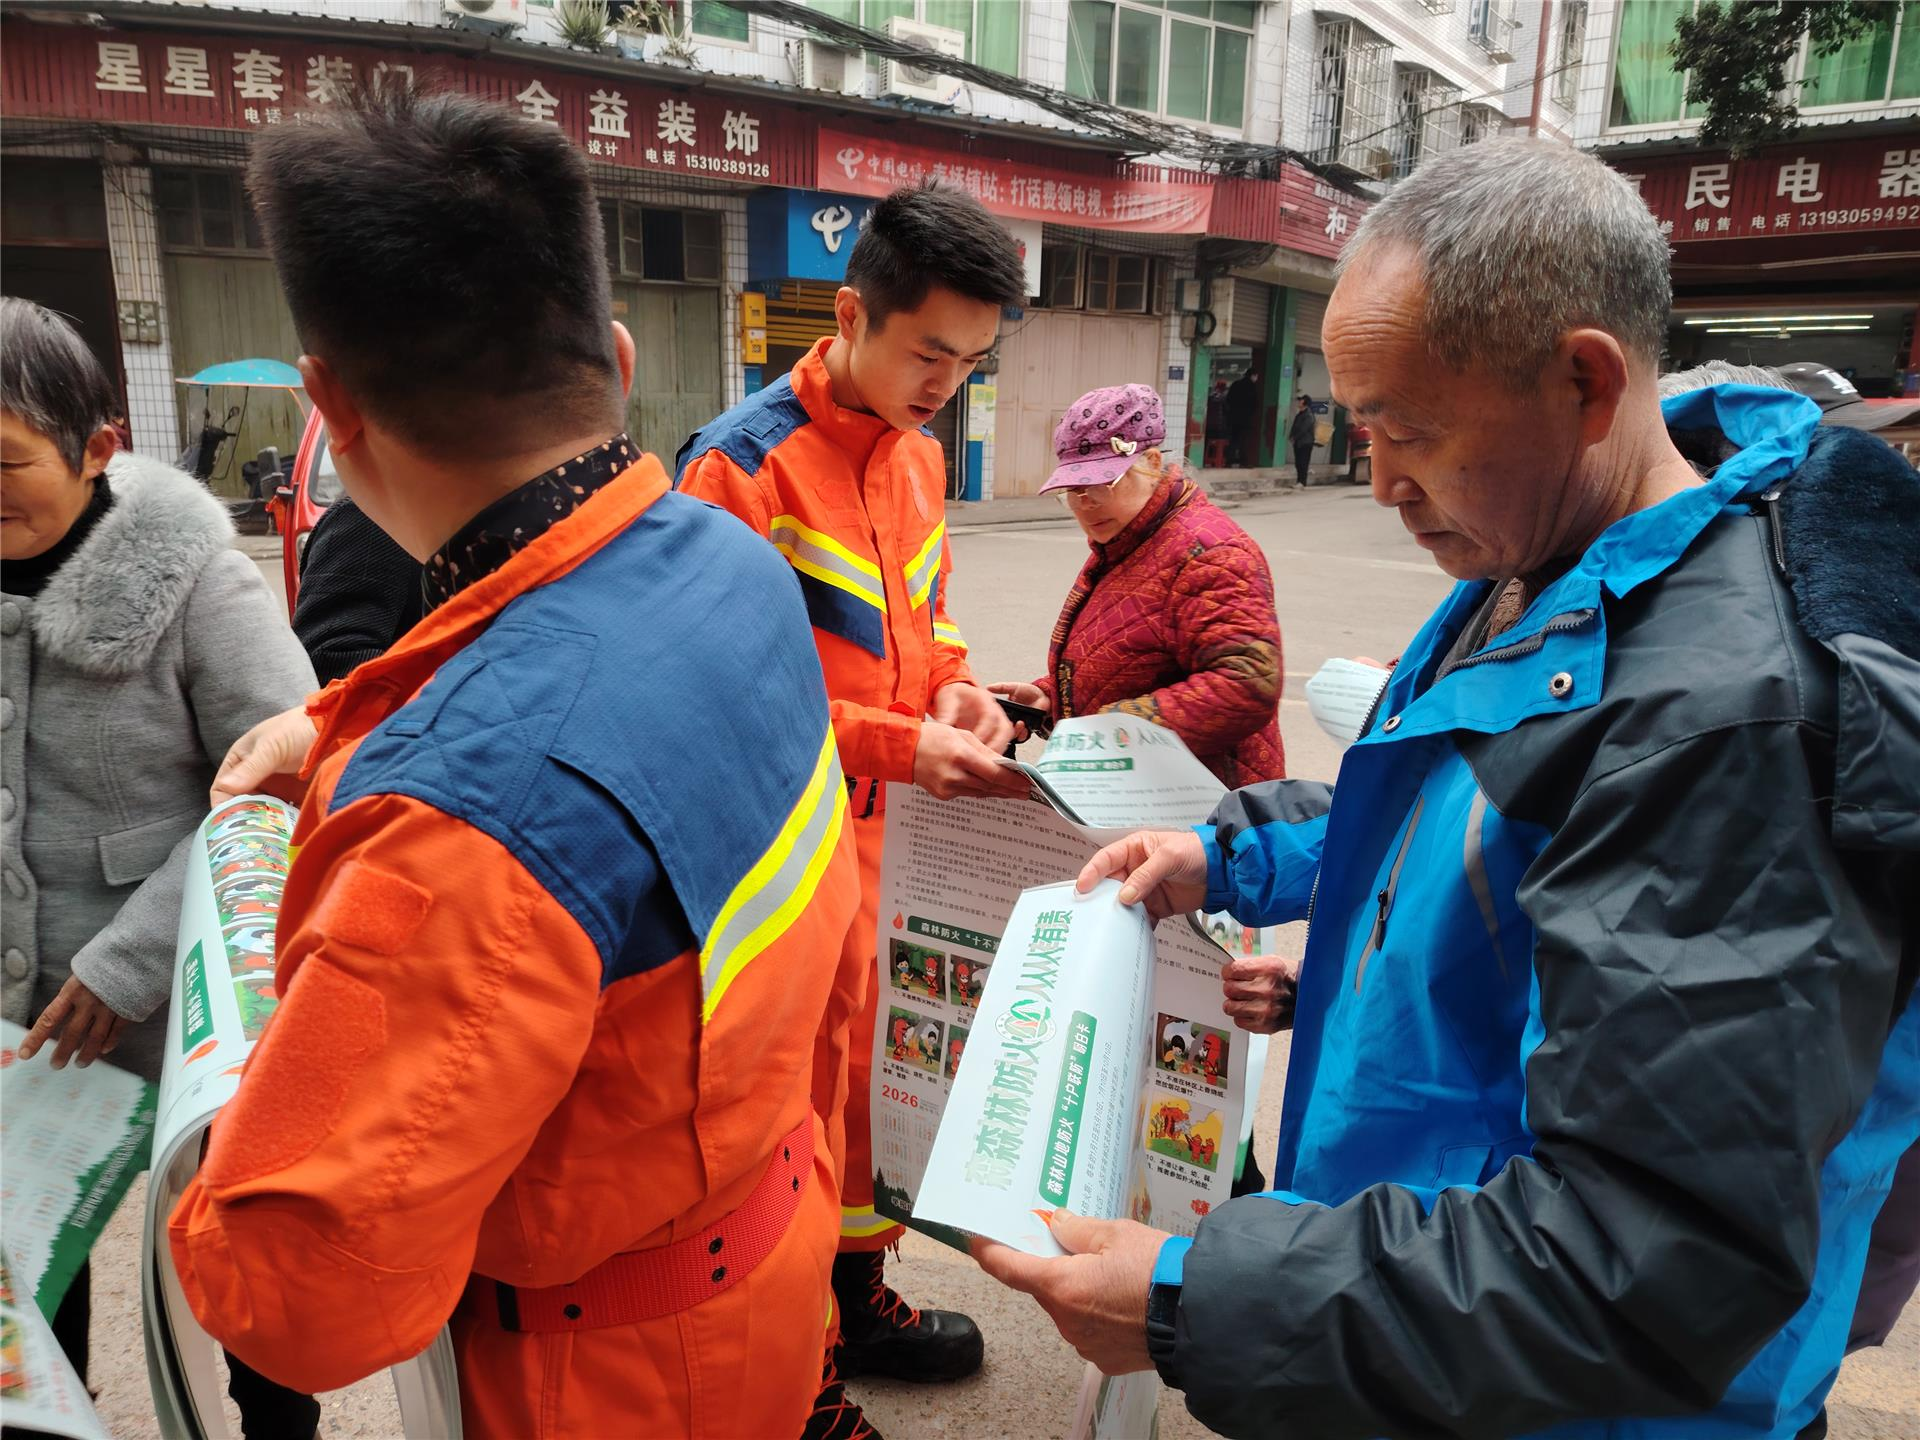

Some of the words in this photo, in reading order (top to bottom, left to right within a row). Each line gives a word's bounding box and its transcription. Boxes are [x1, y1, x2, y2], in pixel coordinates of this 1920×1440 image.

[95, 41, 415, 104] 星星套装门
[244, 106, 282, 125] 电话
[516, 79, 760, 157] 全益装饰
[588, 140, 618, 158] 设计
[645, 147, 677, 166] 电话
[685, 153, 770, 179] 15310389126
[1628, 148, 1920, 211] 民电器
[1324, 206, 1349, 241] 和
[1694, 216, 1732, 233] 销售
[1751, 212, 1792, 230] 电话
[1799, 204, 1919, 228] 13193059492
[881, 1085, 919, 1109] 2026
